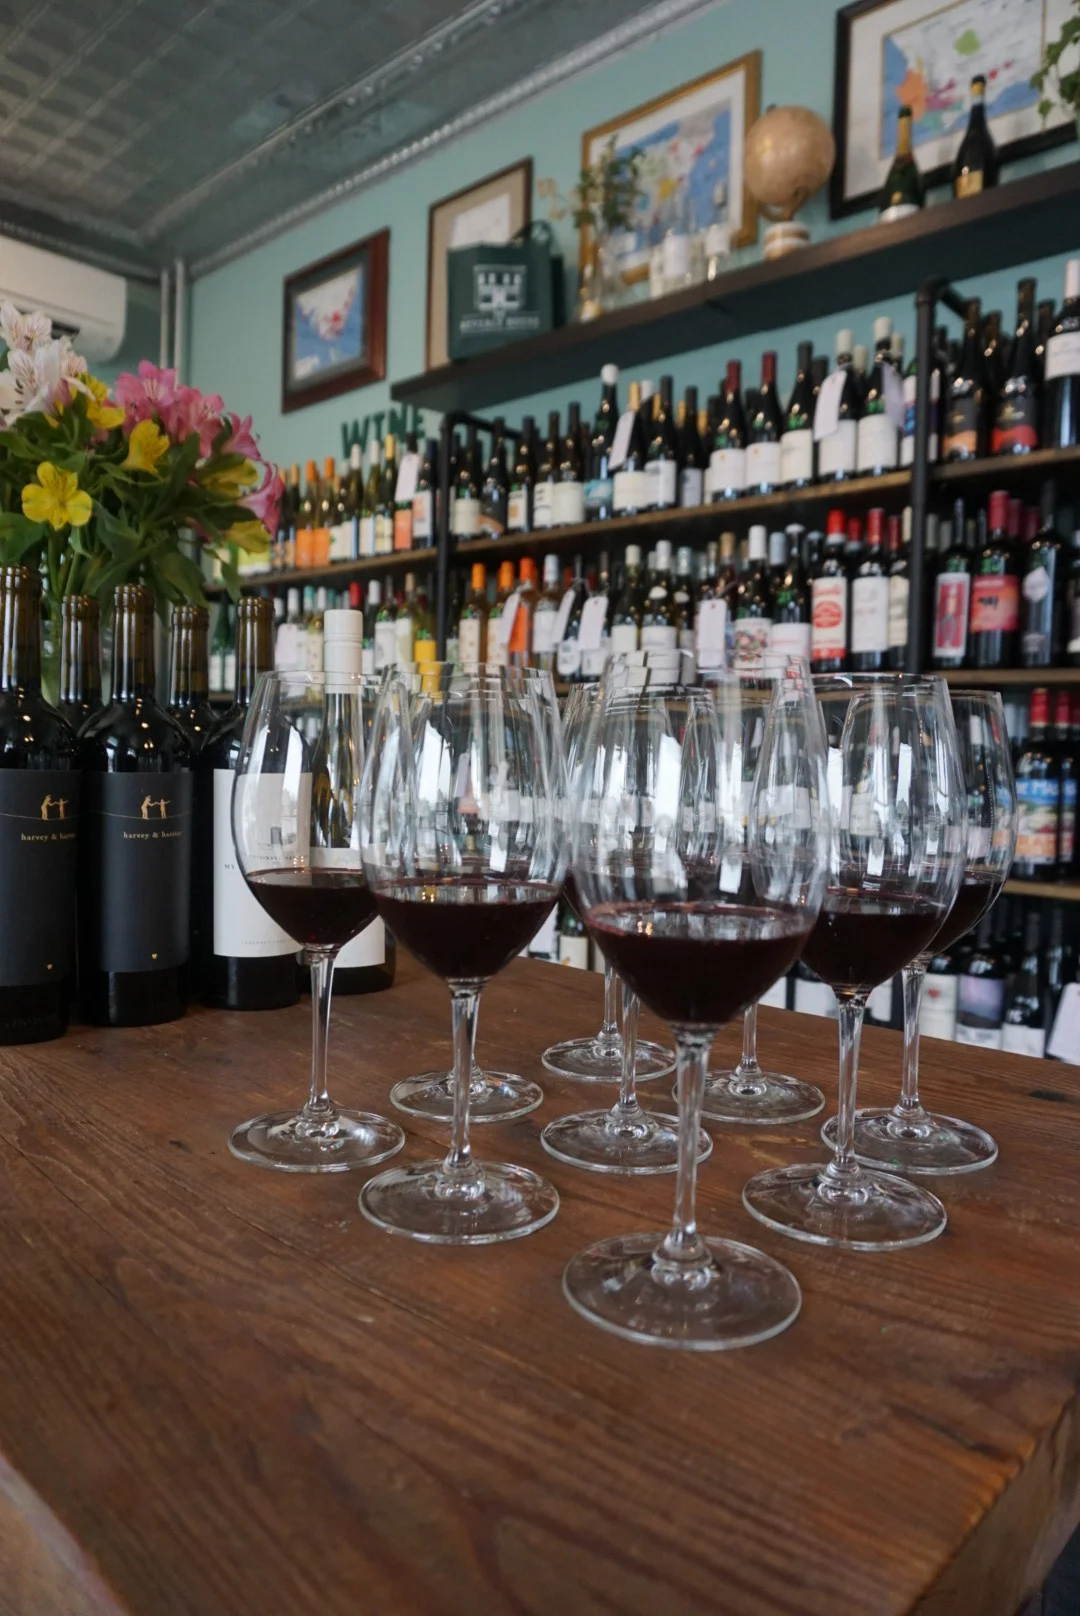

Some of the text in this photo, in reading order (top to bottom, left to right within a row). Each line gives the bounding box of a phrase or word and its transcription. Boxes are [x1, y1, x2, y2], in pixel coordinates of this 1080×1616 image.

[341, 403, 426, 459] WINE
[21, 832, 49, 842] harvey
[50, 832, 57, 840] &
[123, 831, 149, 840] harvey
